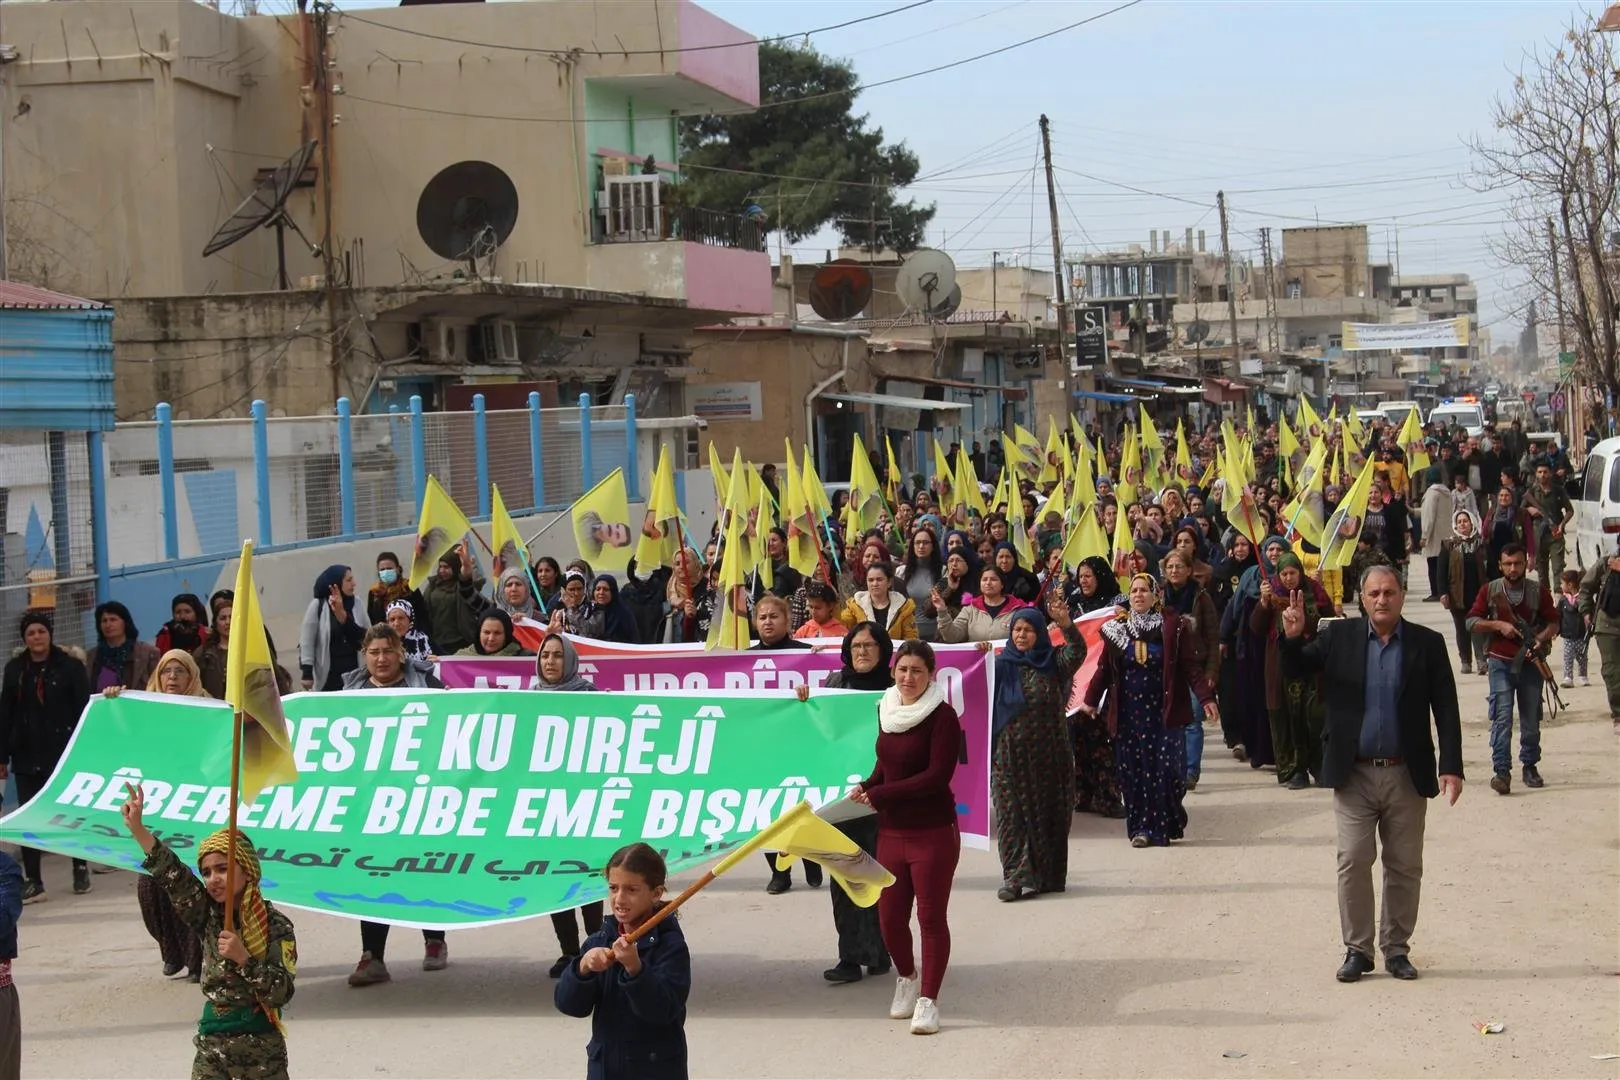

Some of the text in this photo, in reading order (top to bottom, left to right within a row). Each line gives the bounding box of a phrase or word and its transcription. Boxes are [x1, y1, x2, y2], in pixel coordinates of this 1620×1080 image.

[1084, 311, 1096, 332] S
[438, 713, 517, 771] KU
[529, 704, 726, 774] DIRÊJÎ
[506, 776, 633, 838] EMÊ
[354, 852, 476, 878] التي
